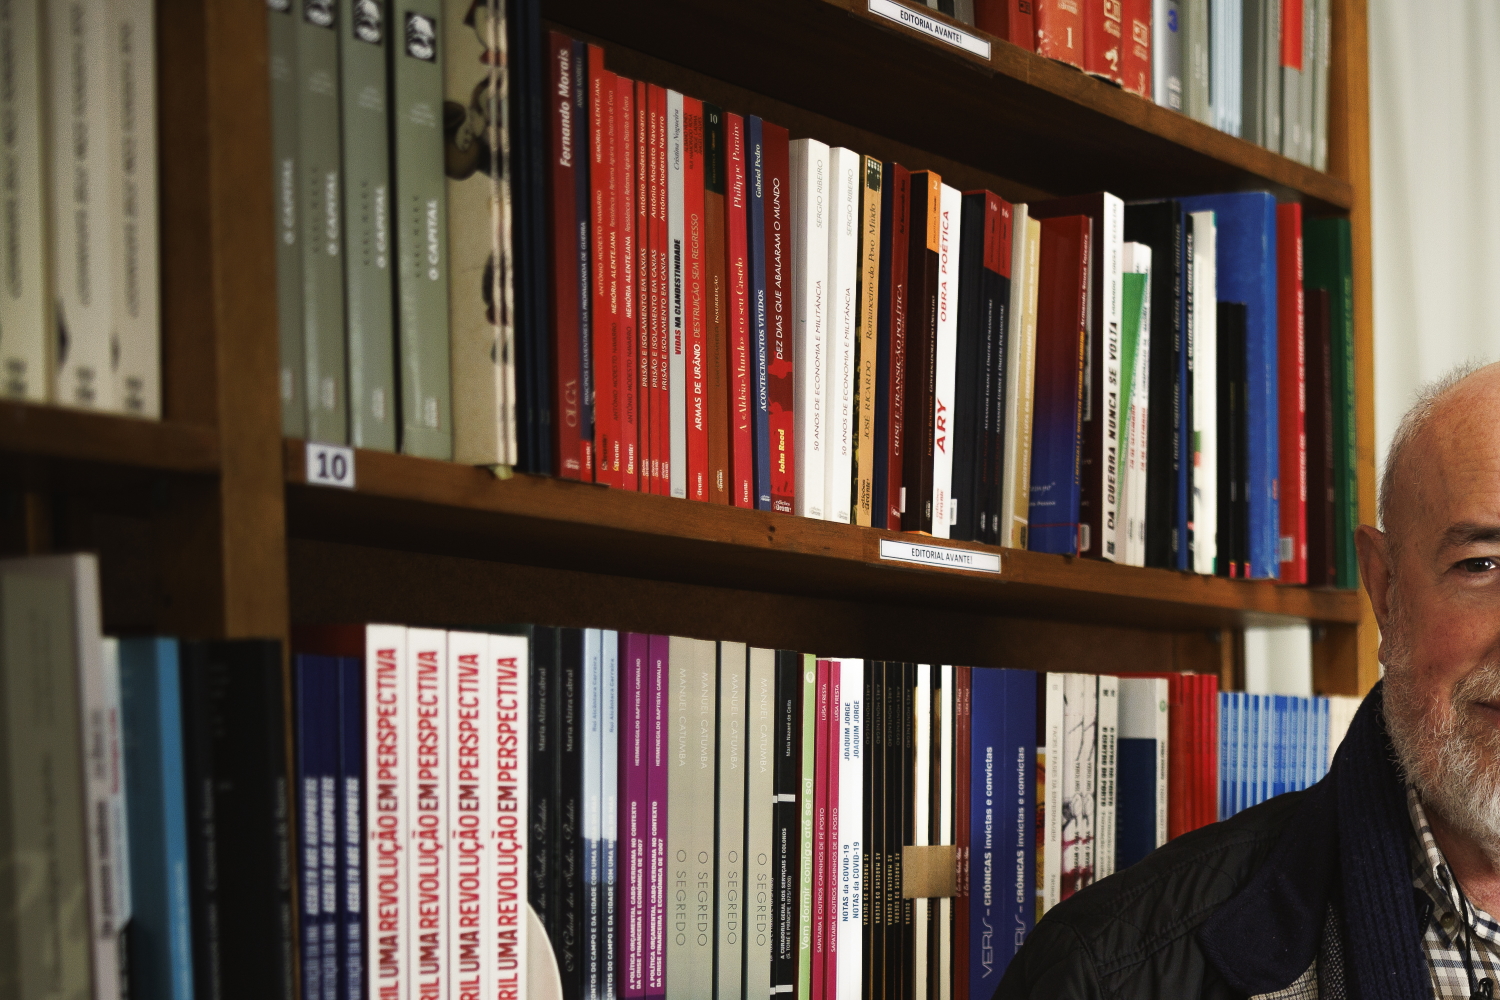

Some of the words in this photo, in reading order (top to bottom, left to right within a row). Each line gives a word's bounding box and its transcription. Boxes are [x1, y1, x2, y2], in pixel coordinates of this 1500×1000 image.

[900, 9, 934, 35] EDITORIAL
[934, 22, 963, 44] AVANTE!
[557, 48, 570, 98] Morais
[558, 100, 572, 167] Fernando
[752, 143, 762, 168] Pedro
[753, 168, 762, 198] Gabriel
[772, 177, 780, 219] MUNDO
[773, 221, 781, 231] O
[868, 202, 876, 235] Miúdo
[690, 213, 699, 260] REGRESSO
[867, 239, 875, 262] Povo
[939, 210, 948, 275] POÉTICA
[672, 238, 682, 315] CLANDESTINIDADE
[691, 261, 699, 280] SEM
[773, 233, 782, 288] ABALARAM
[867, 266, 874, 279] do
[624, 285, 632, 318] MEMÓRIA
[660, 283, 666, 297] EM
[774, 290, 782, 313] QUE
[813, 279, 821, 334] MILITÂNCIA
[939, 280, 947, 322] OBRA
[674, 316, 681, 329] NA
[690, 282, 701, 338] DESTRUIÇÃO
[756, 289, 765, 327] VIVIDOS
[865, 281, 873, 340] Romanceiro
[674, 329, 682, 355] VIDAS
[775, 340, 783, 360] DEZ
[1108, 321, 1117, 360] VOLTA
[660, 361, 668, 391] PRISÃO
[691, 340, 701, 379] URÂNIO:
[757, 329, 768, 412] ACONTECIMENTOS
[1108, 366, 1117, 385] SE
[693, 381, 701, 394] DE
[863, 360, 872, 411] RICARDO
[693, 397, 702, 431] ARMAS
[813, 397, 819, 411] DE
[1108, 391, 1116, 440] NUNCA
[777, 428, 785, 451] Reed
[862, 414, 870, 440] JOSÉ
[935, 397, 946, 454] ARY
[812, 440, 819, 452] 50
[318, 452, 347, 481] 10
[1106, 510, 1114, 530] DA
[911, 548, 944, 561] EDITORIAL
[946, 553, 973, 565] AVANTE!
[377, 649, 397, 781] PERSPECTIVA
[418, 651, 438, 781] PERSPECTIVA
[458, 654, 479, 782] PERSPECTIVA
[497, 657, 518, 783] PERSPECTIVA
[843, 701, 851, 726] JORGE
[852, 699, 860, 724] JORGE
[842, 727, 850, 761] JOAQUIM
[852, 725, 860, 759] JOAQUIM
[984, 746, 993, 797] convictas
[378, 784, 398, 812] EM
[418, 784, 439, 812] EM
[459, 784, 480, 812] EM
[497, 785, 518, 812] EM
[984, 808, 992, 849] invictas
[412, 814, 443, 930] REVOLUÇÃO
[452, 814, 484, 929] REVOLUÇÃO
[491, 815, 522, 928] REVOLUÇÃO
[676, 849, 686, 862] O
[757, 852, 767, 866] O
[842, 843, 850, 882] COVID-19
[851, 841, 860, 879] COVID-19
[371, 814, 402, 932] REVOLUÇÃO
[841, 884, 849, 894] da
[851, 880, 859, 891] da
[982, 852, 992, 907] CRÓNICAS
[676, 870, 686, 946] SEGREDO
[756, 872, 767, 946] SEGREDO
[841, 896, 849, 922] NOTAS
[851, 893, 859, 919] NOTAS
[379, 934, 399, 979] UMA
[419, 932, 440, 975] UMA
[459, 930, 480, 973] UMA
[498, 929, 518, 971] UMA
